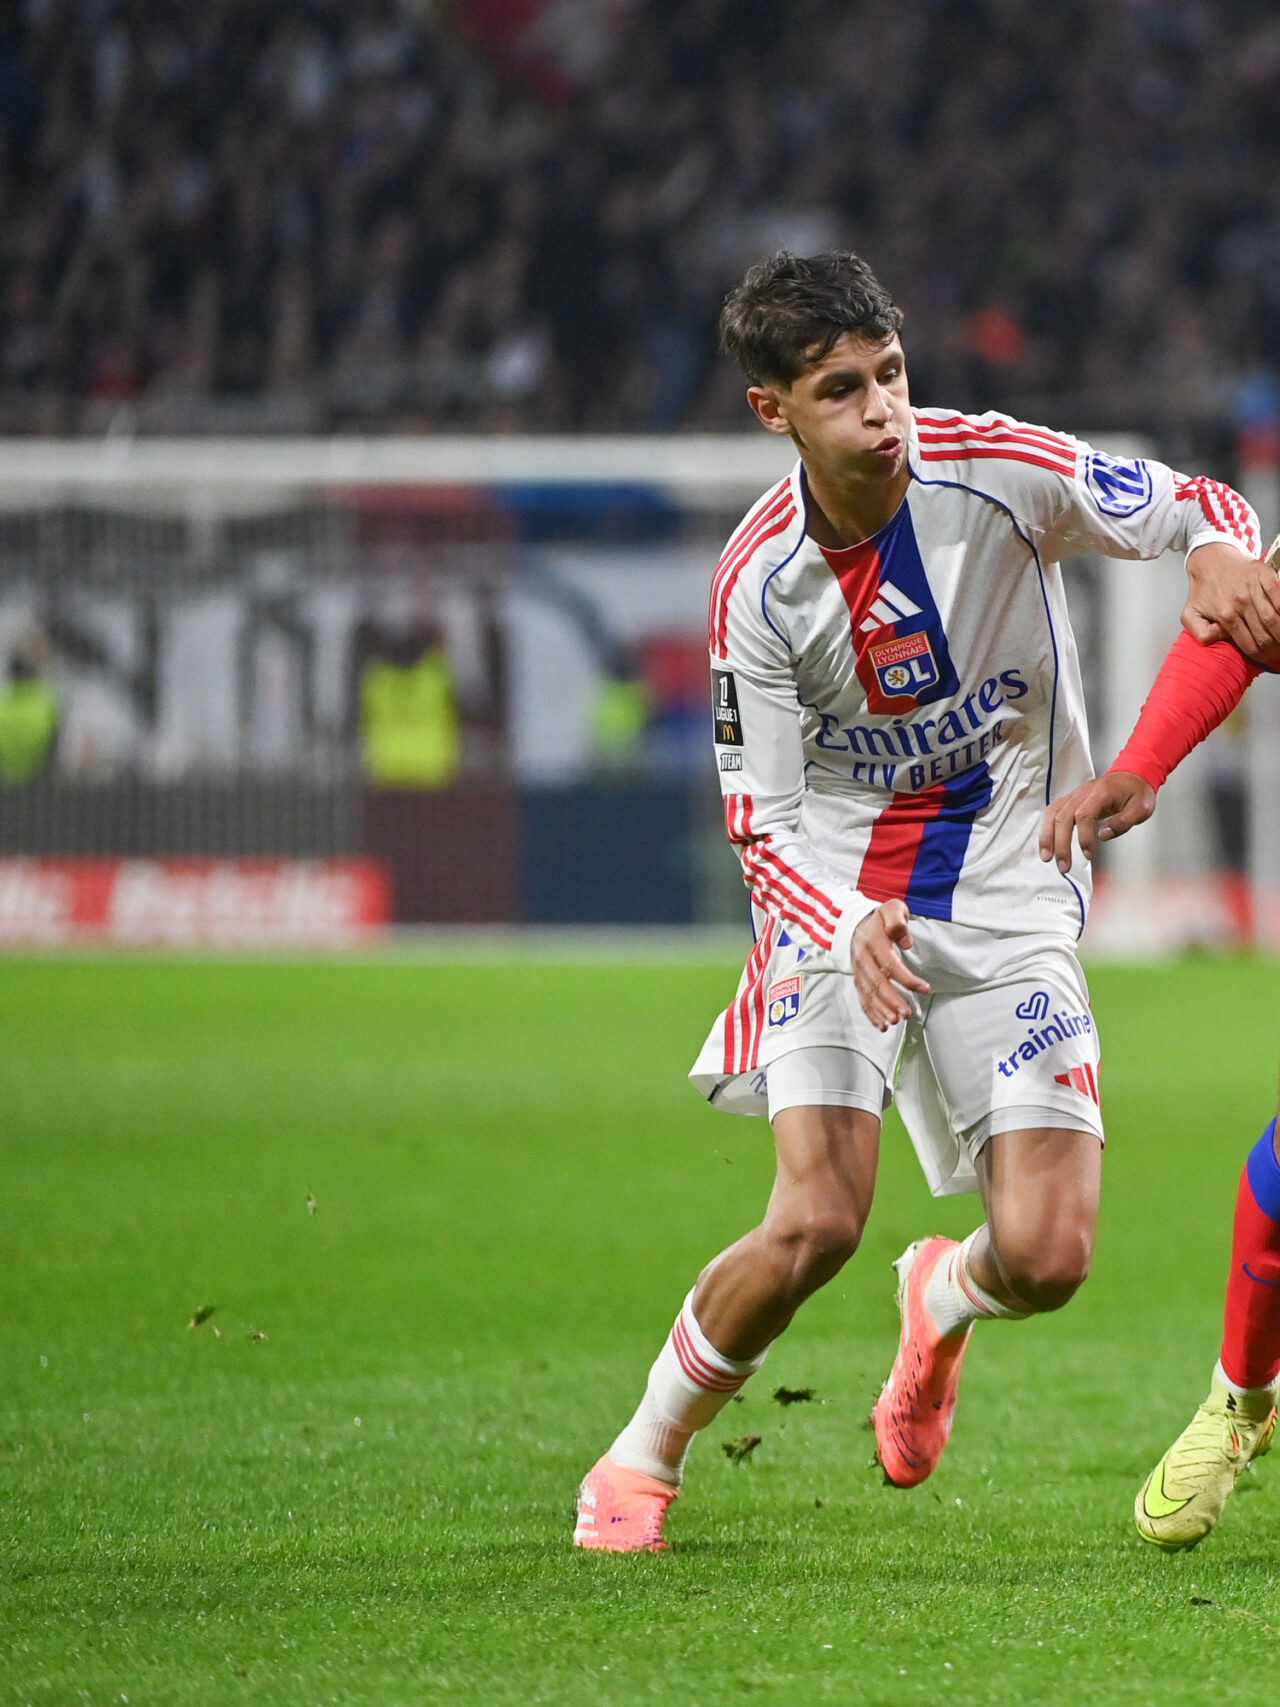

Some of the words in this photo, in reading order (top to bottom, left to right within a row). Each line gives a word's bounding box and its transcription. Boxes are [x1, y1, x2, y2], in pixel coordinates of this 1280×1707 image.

[874, 637, 923, 657] OLYMPIQUE
[877, 644, 925, 665] LYONNAIS
[815, 669, 1029, 757] Emirates
[909, 720, 1003, 792] BETTER
[998, 1010, 1091, 1078] trainline
